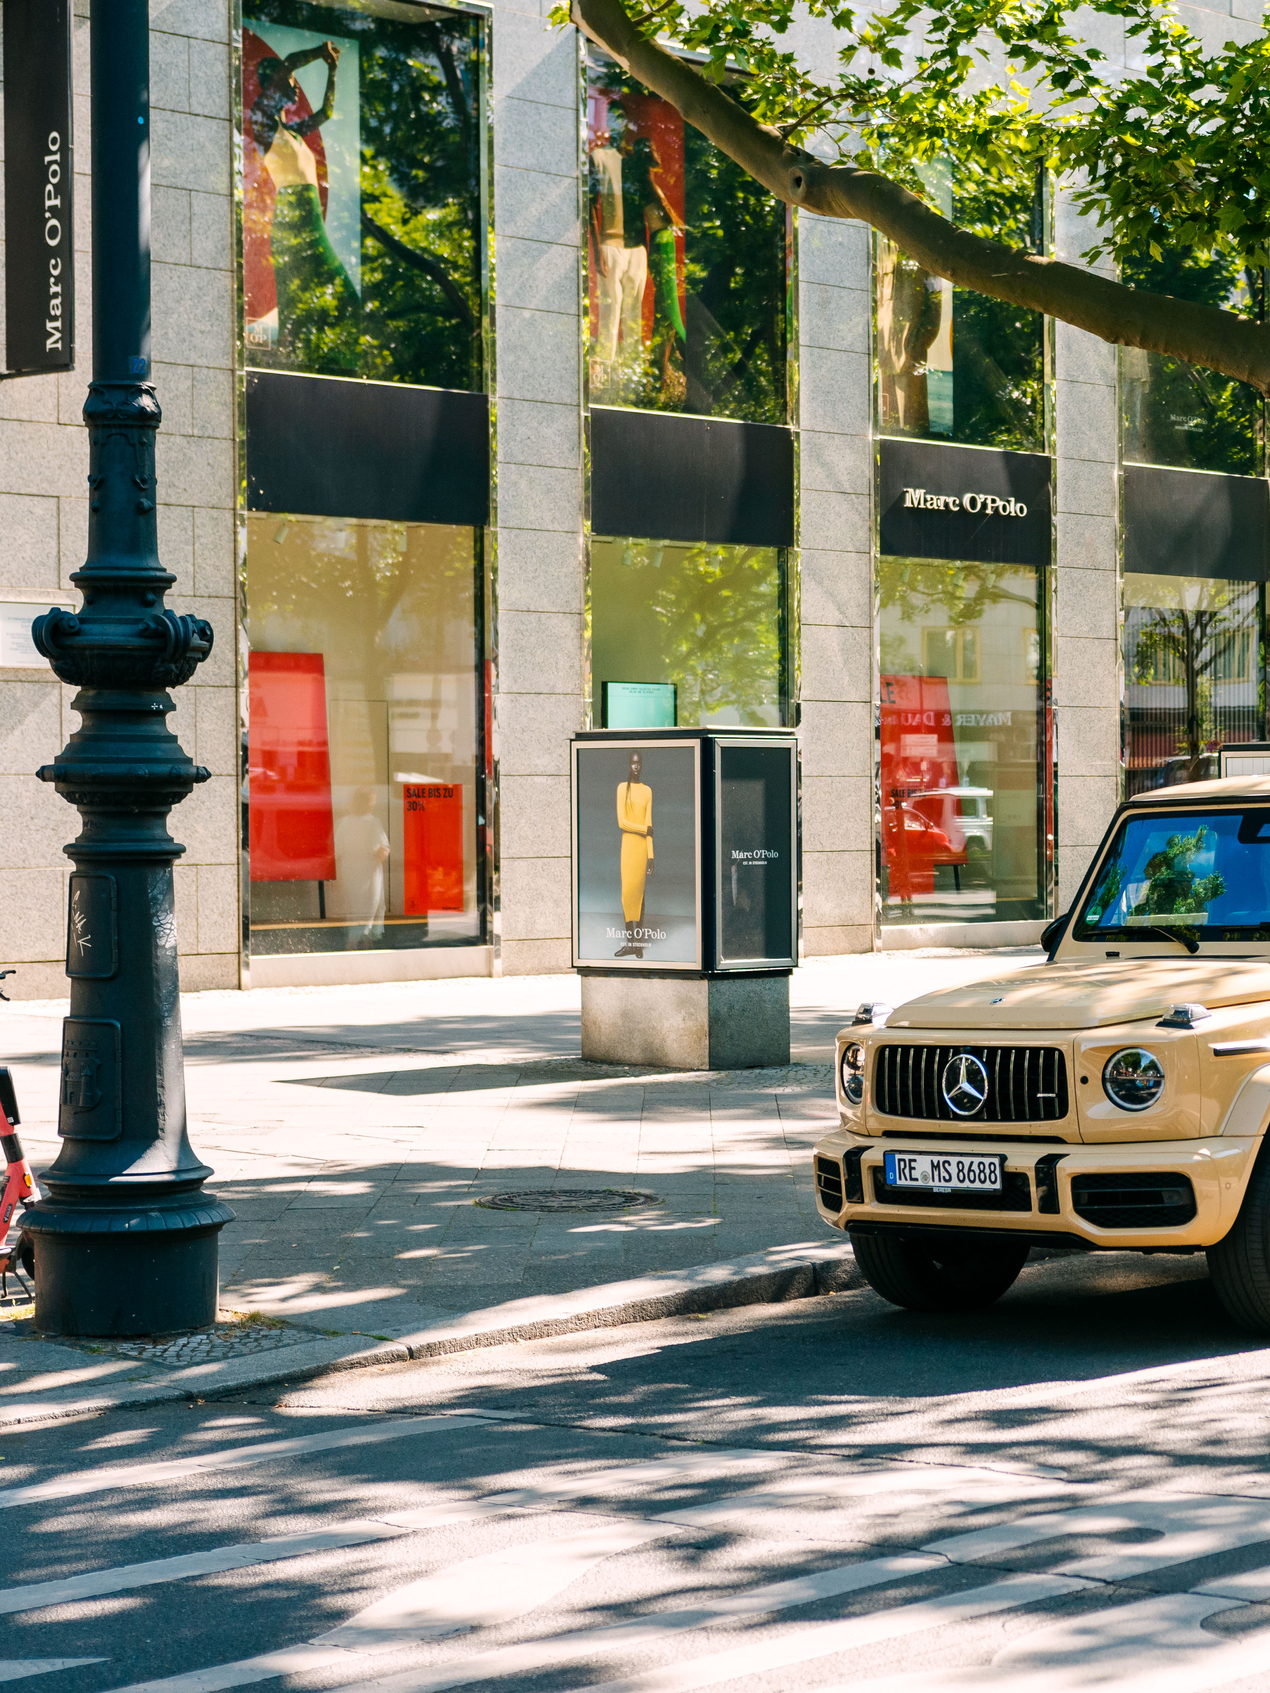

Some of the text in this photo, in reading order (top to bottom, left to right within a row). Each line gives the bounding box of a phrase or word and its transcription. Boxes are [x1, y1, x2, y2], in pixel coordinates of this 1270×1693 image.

[44, 131, 62, 352] Marc O'Polo
[903, 487, 1027, 517] Marc O'Polo
[406, 788, 454, 798] SALE BIS ZU
[891, 789, 905, 798] SALE
[406, 801, 425, 811] 30%
[731, 850, 779, 859] Marc O'Polo
[606, 927, 667, 939] Marc O'Polo
[897, 1158, 919, 1182] RE
[931, 1159, 952, 1183] MS
[956, 1160, 998, 1185] 8688
